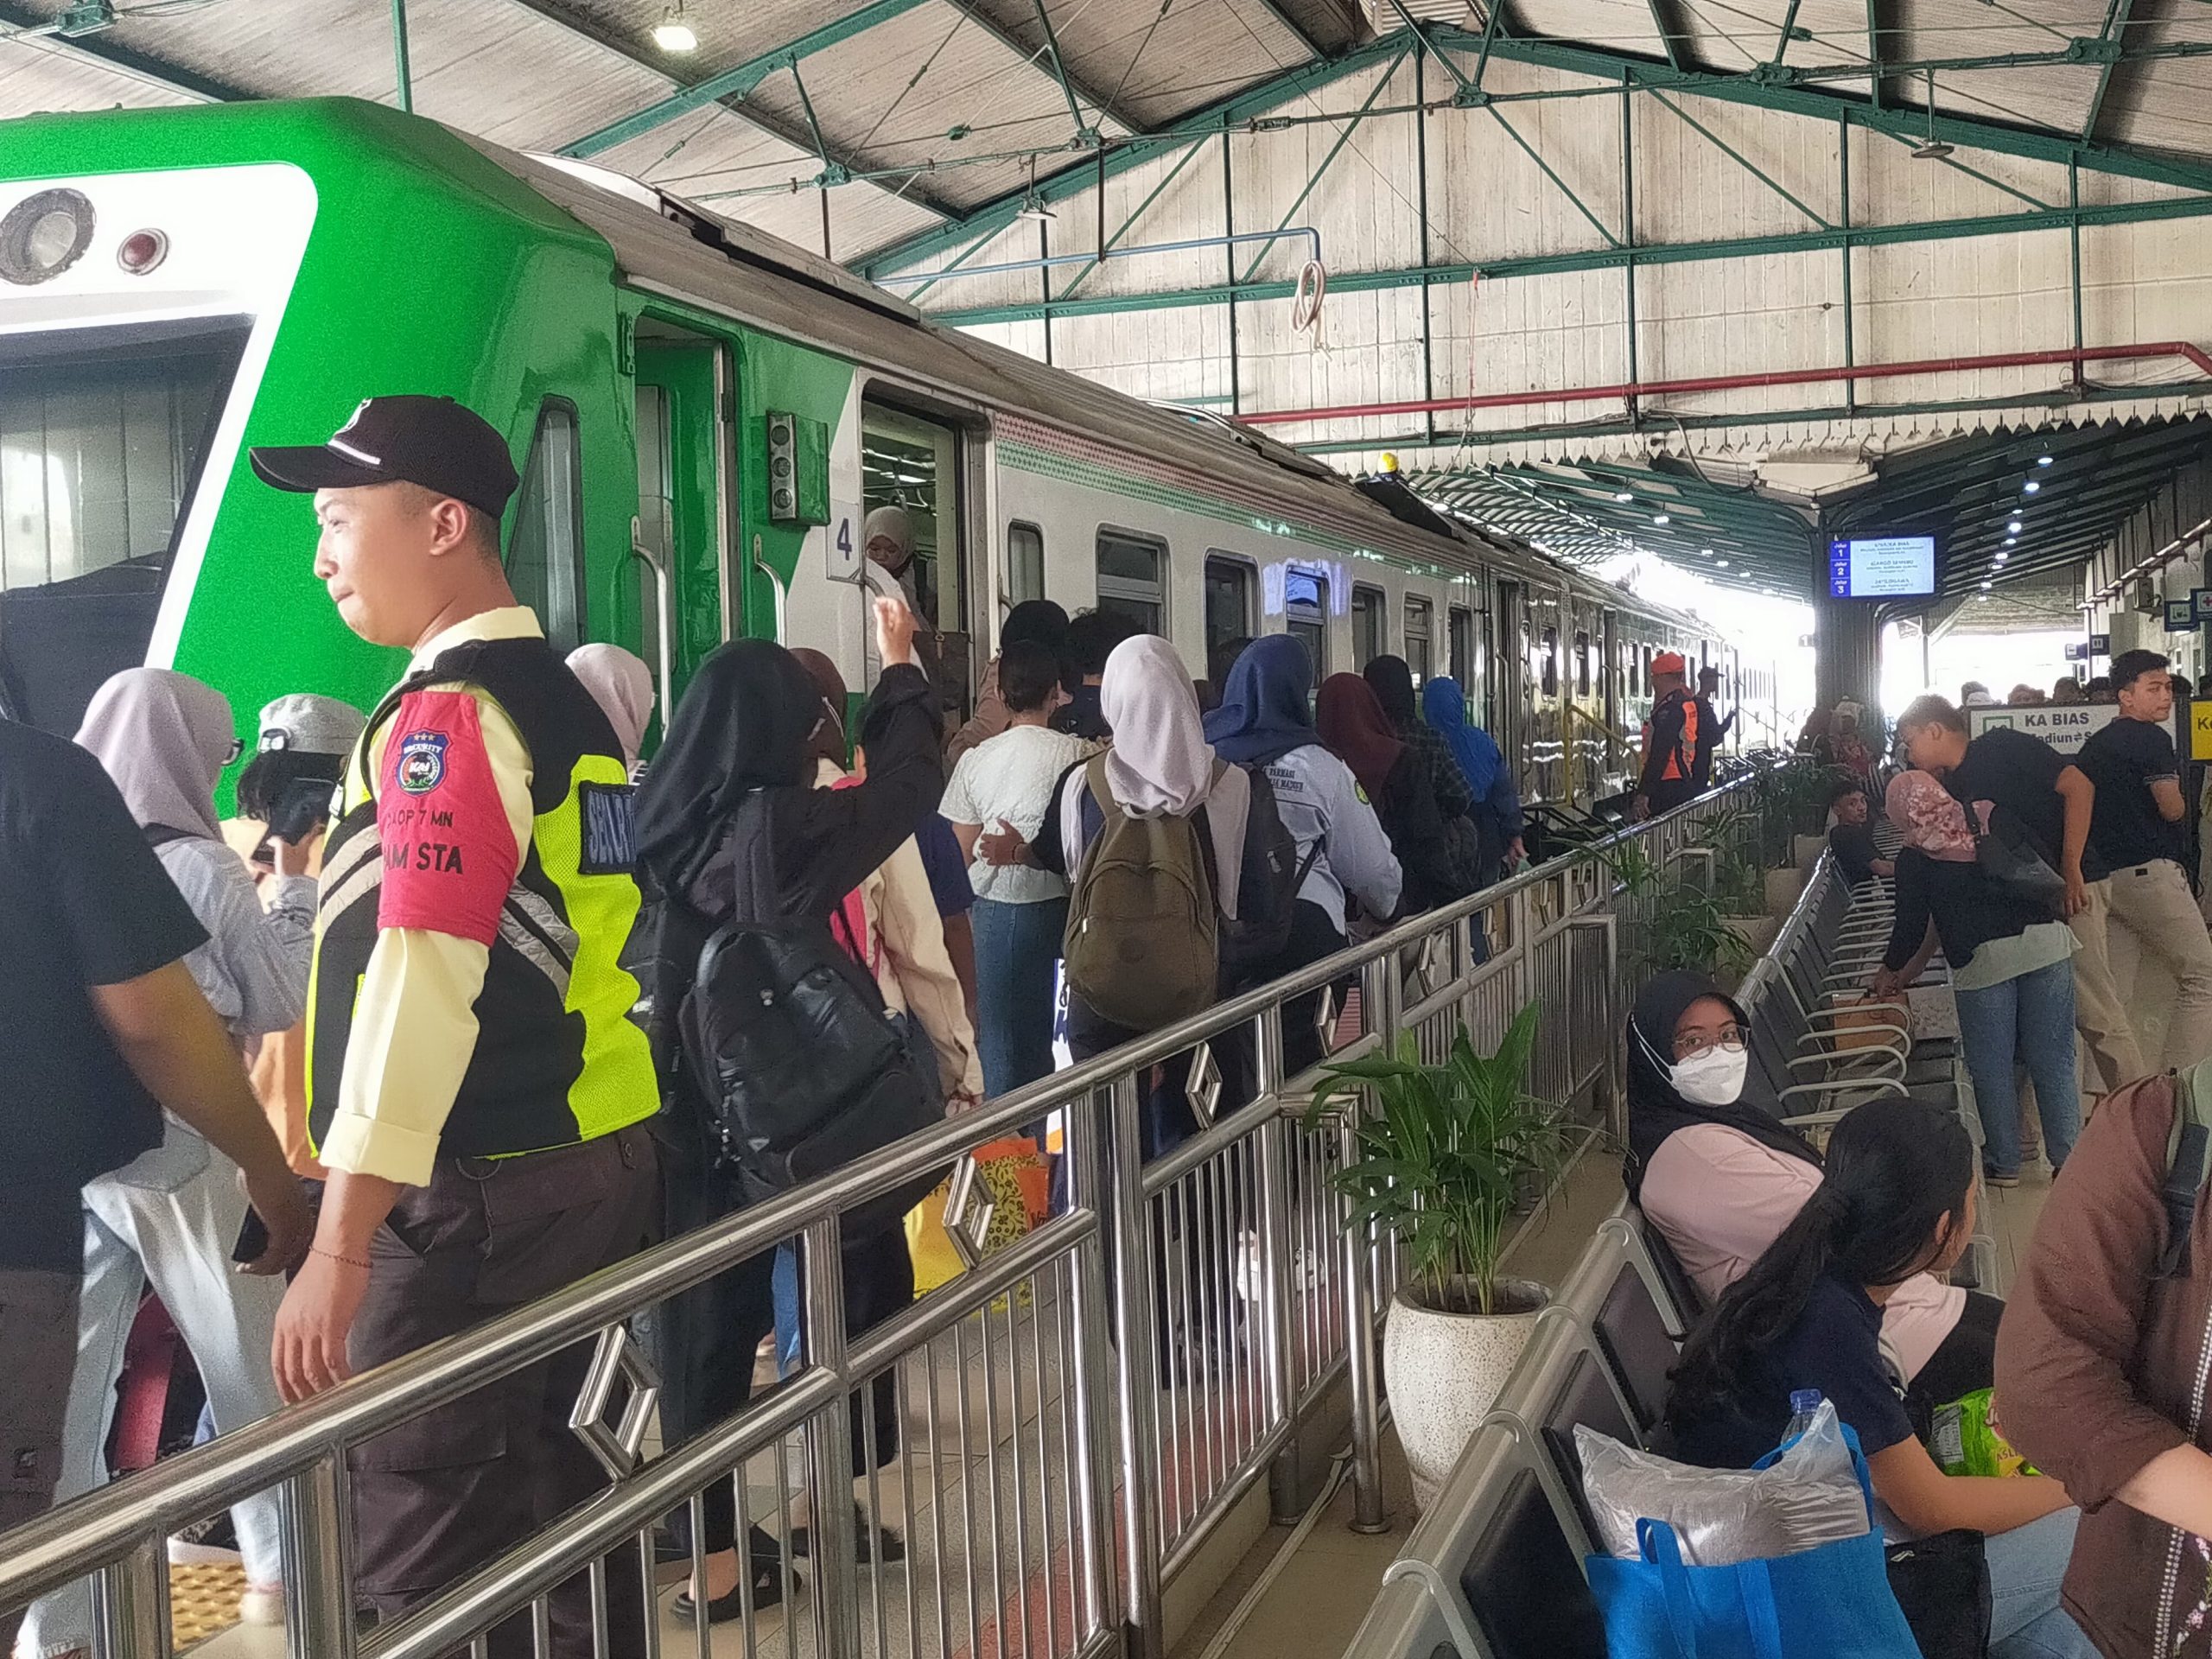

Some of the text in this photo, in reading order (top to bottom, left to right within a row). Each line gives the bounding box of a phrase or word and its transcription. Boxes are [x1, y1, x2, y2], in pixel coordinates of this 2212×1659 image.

[836, 518, 852, 561] 4
[2024, 712, 2089, 727] KA BIAS
[418, 809, 427, 825] 7
[430, 809, 453, 828] MN
[416, 842, 463, 874] STA
